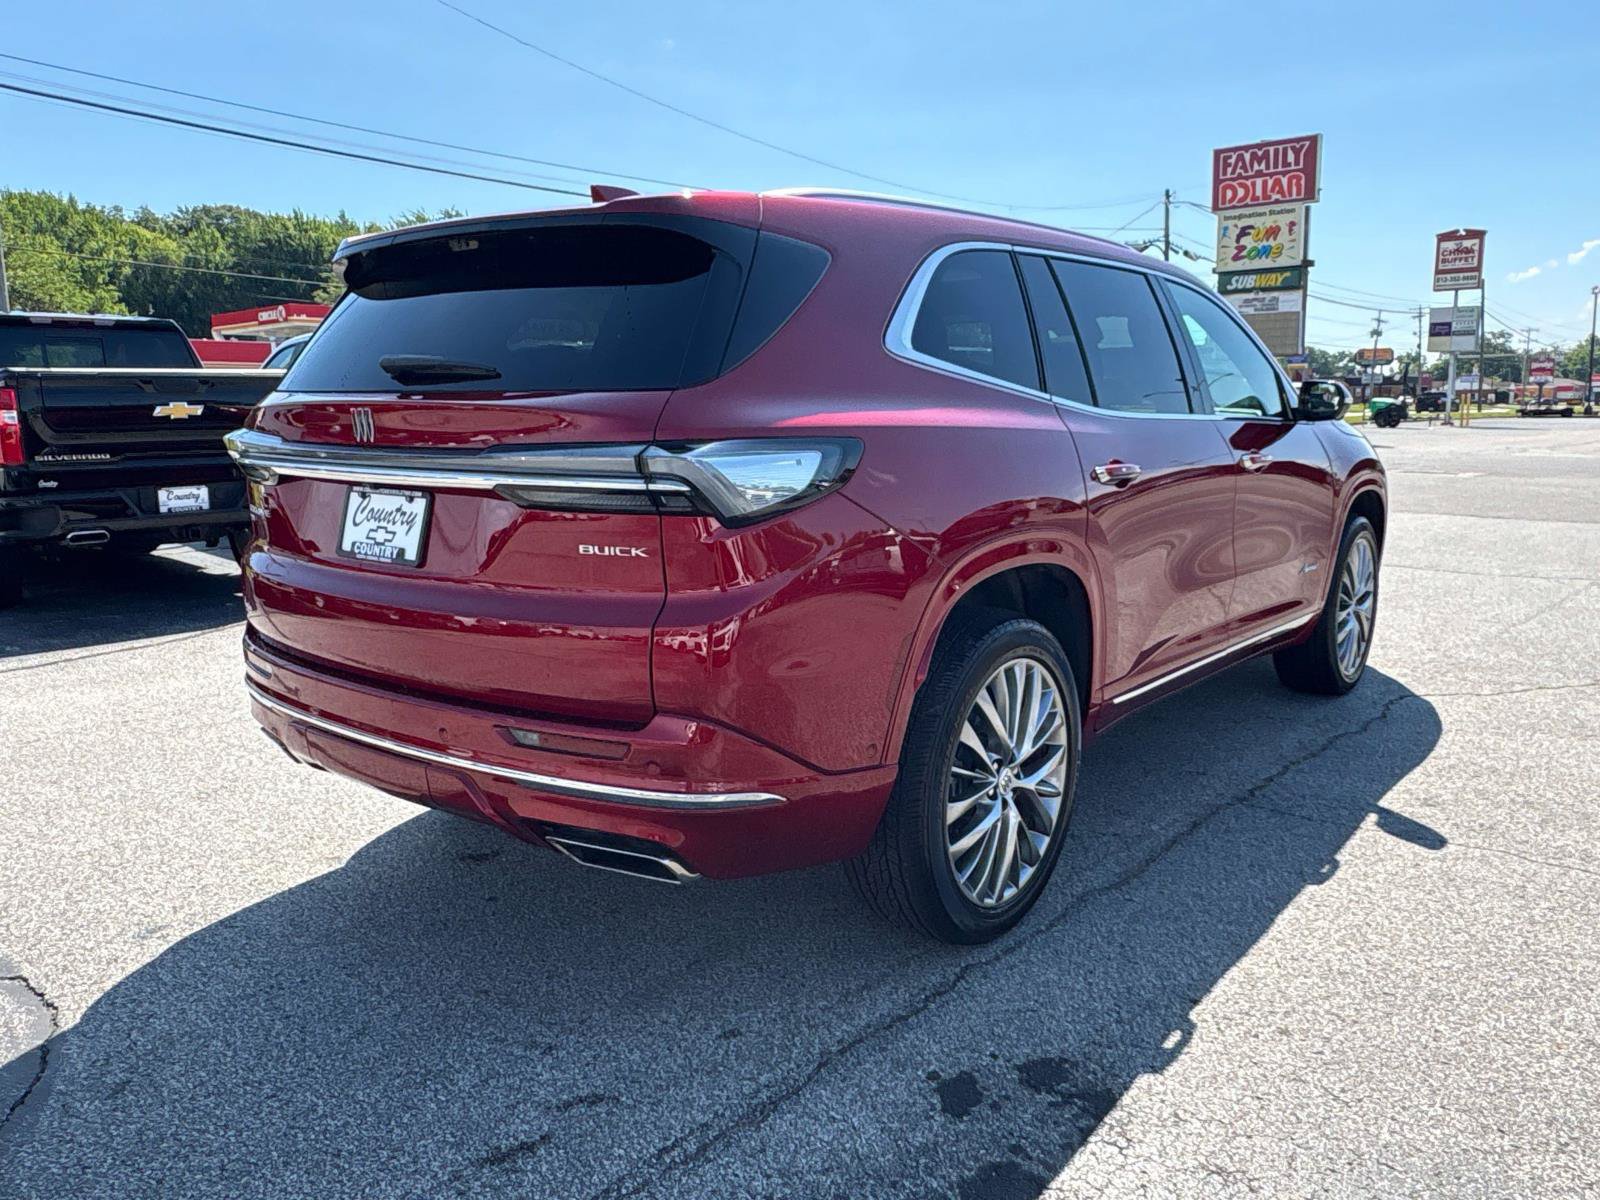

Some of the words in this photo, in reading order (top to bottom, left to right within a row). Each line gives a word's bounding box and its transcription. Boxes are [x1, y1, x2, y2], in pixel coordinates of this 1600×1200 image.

[1219, 140, 1311, 179] FAMILY
[1219, 171, 1305, 208] DOLLAR
[1223, 211, 1267, 222] Imagination
[1268, 207, 1296, 216] Station
[1234, 224, 1282, 245] Fun
[1441, 256, 1476, 264] BUFFET
[1226, 271, 1291, 291] SUBWAY
[34, 453, 111, 462] SILVERADO
[167, 490, 201, 503] Country
[353, 495, 418, 536] Country
[354, 542, 399, 559] COUNTRY
[578, 544, 649, 558] BUICK
